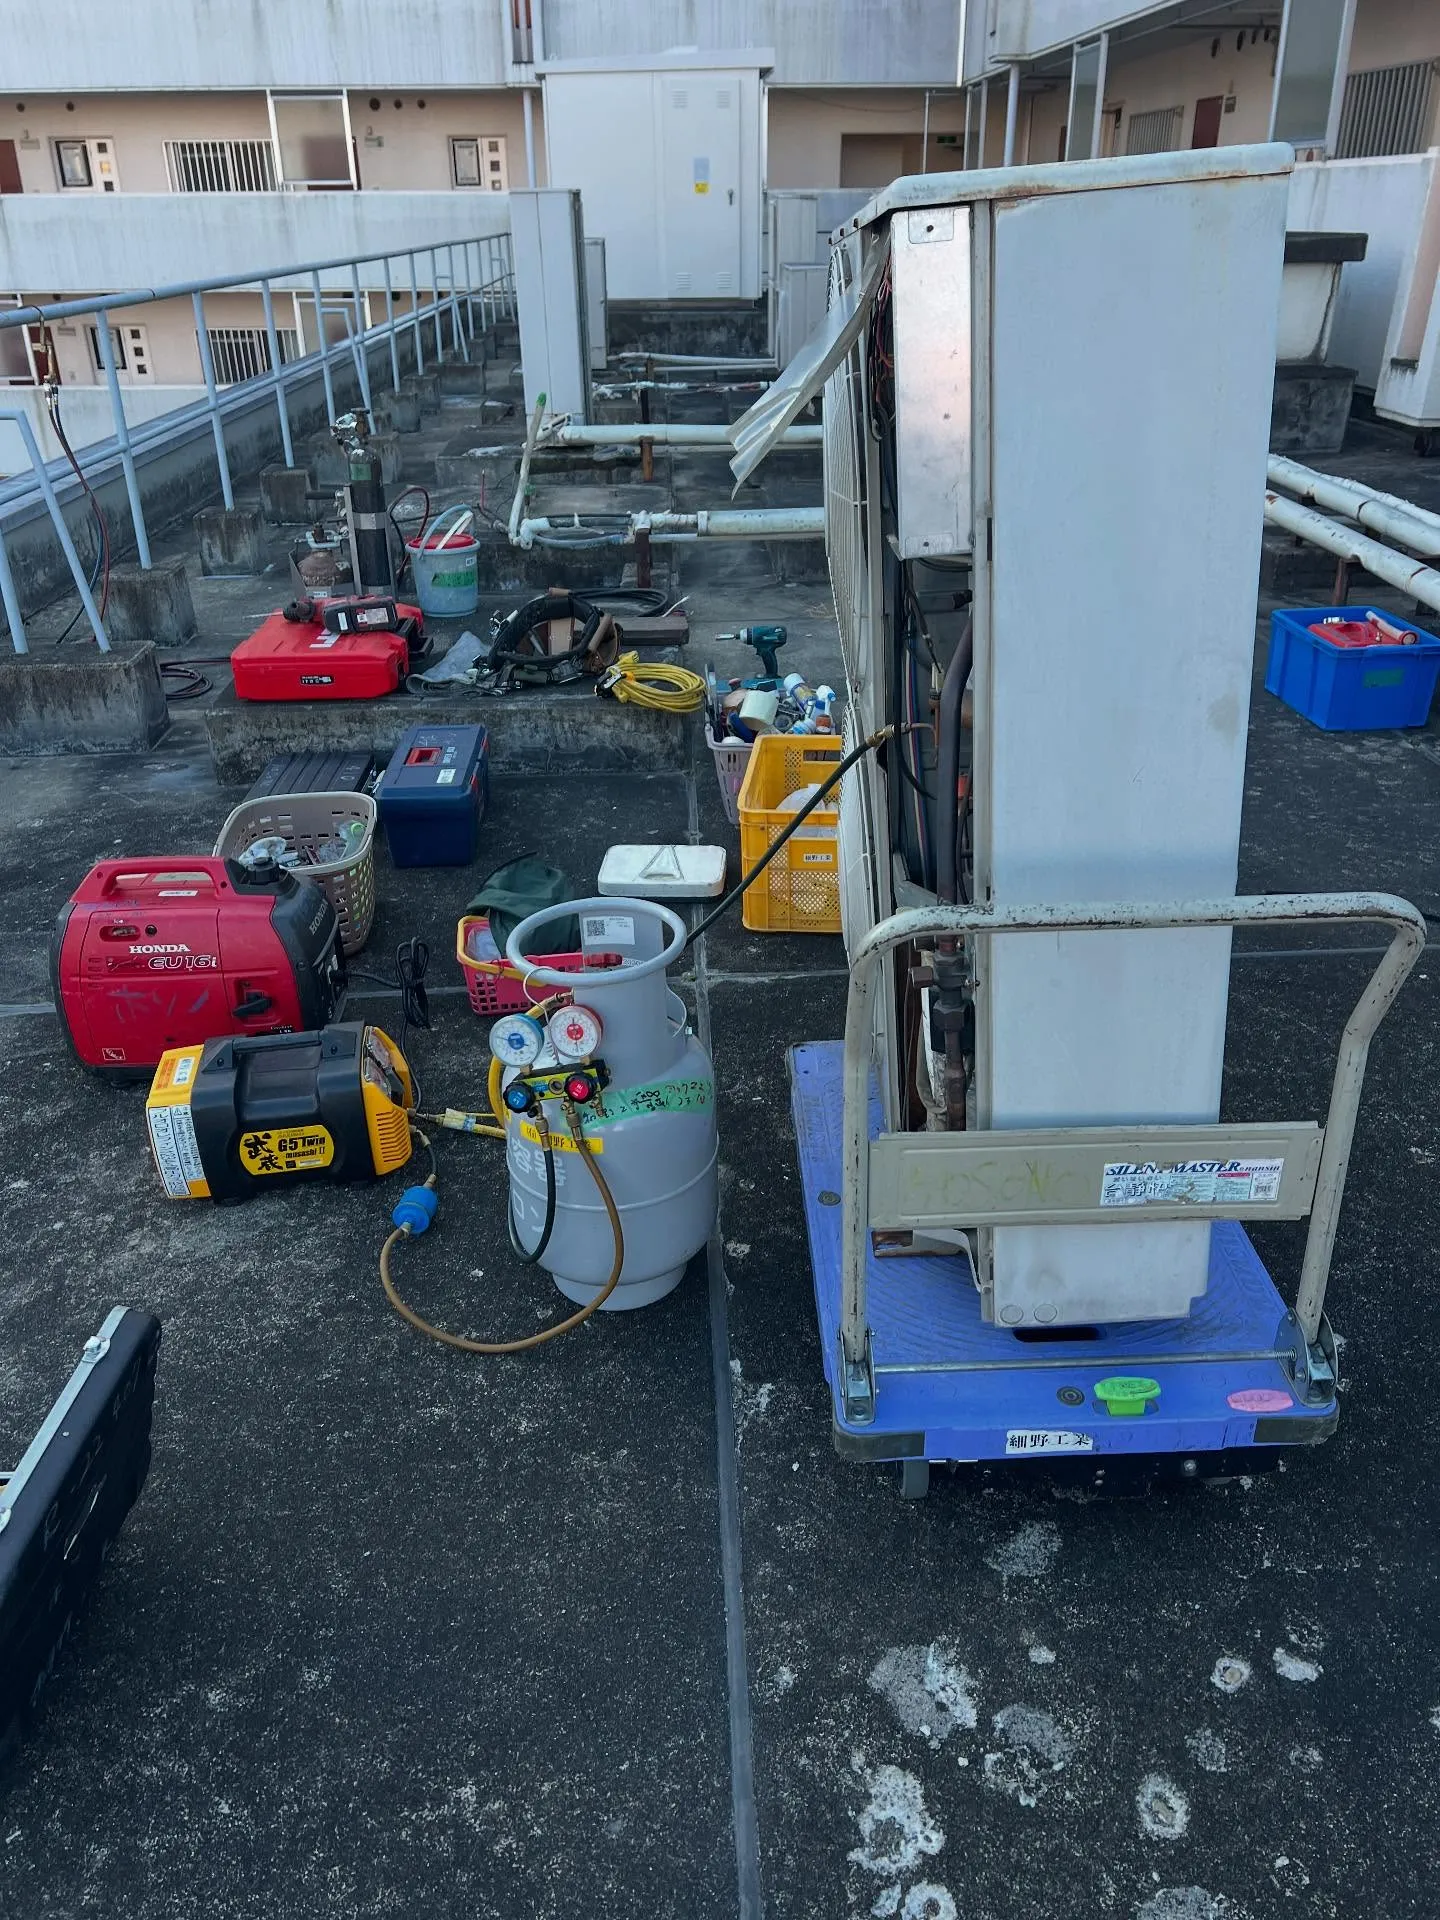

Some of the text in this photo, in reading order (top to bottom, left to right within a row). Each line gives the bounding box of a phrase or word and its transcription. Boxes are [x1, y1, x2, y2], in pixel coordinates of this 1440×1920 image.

[128, 944, 191, 954] HONDA
[148, 955, 217, 970] EU16i
[278, 1137, 299, 1152] G5
[1168, 1161, 1241, 1174] MASTER
